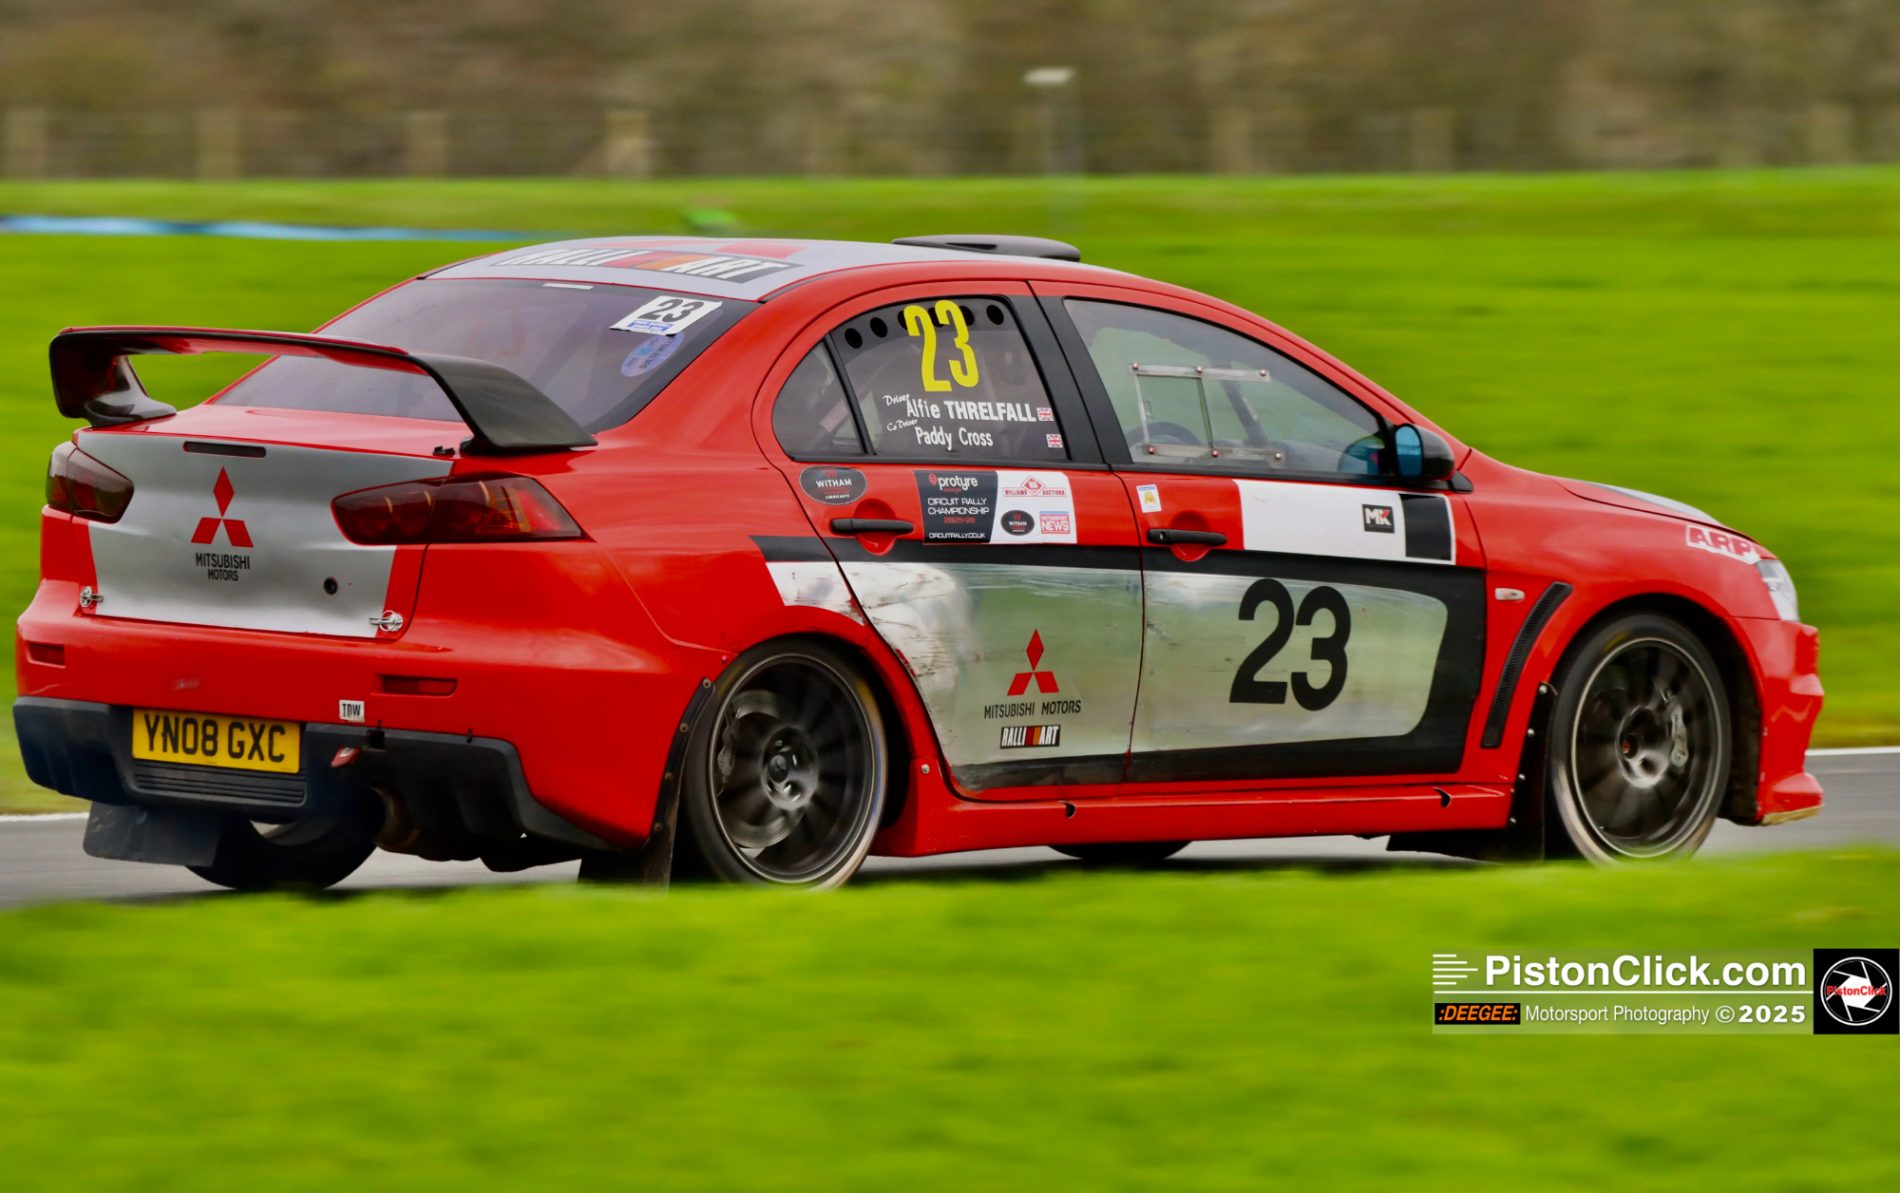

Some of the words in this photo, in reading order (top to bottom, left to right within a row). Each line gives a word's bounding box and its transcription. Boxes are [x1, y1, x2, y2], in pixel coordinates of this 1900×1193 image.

[638, 299, 704, 322] 23
[903, 300, 979, 391] 23
[906, 399, 940, 418] Alfie
[943, 401, 1036, 422] THRELFALL
[914, 426, 953, 451] Paddy
[958, 428, 993, 446] Cross
[815, 478, 852, 488] WITHAM
[938, 475, 979, 491] protyre
[927, 497, 959, 506] CIRCUIT
[961, 498, 987, 506] RALLY
[927, 507, 990, 516] CHAMPIONSHIP
[1364, 507, 1393, 526] MK
[1041, 519, 1070, 531] NEWS
[1689, 527, 1752, 557] ARP
[195, 553, 250, 570] MITSUBISHI
[207, 569, 239, 581] MOTORS
[1229, 577, 1352, 712] 23
[984, 703, 1035, 719] MITSUBISHI
[1041, 701, 1081, 715] MOTORS
[144, 714, 218, 757] YN08
[228, 722, 285, 763] GXC
